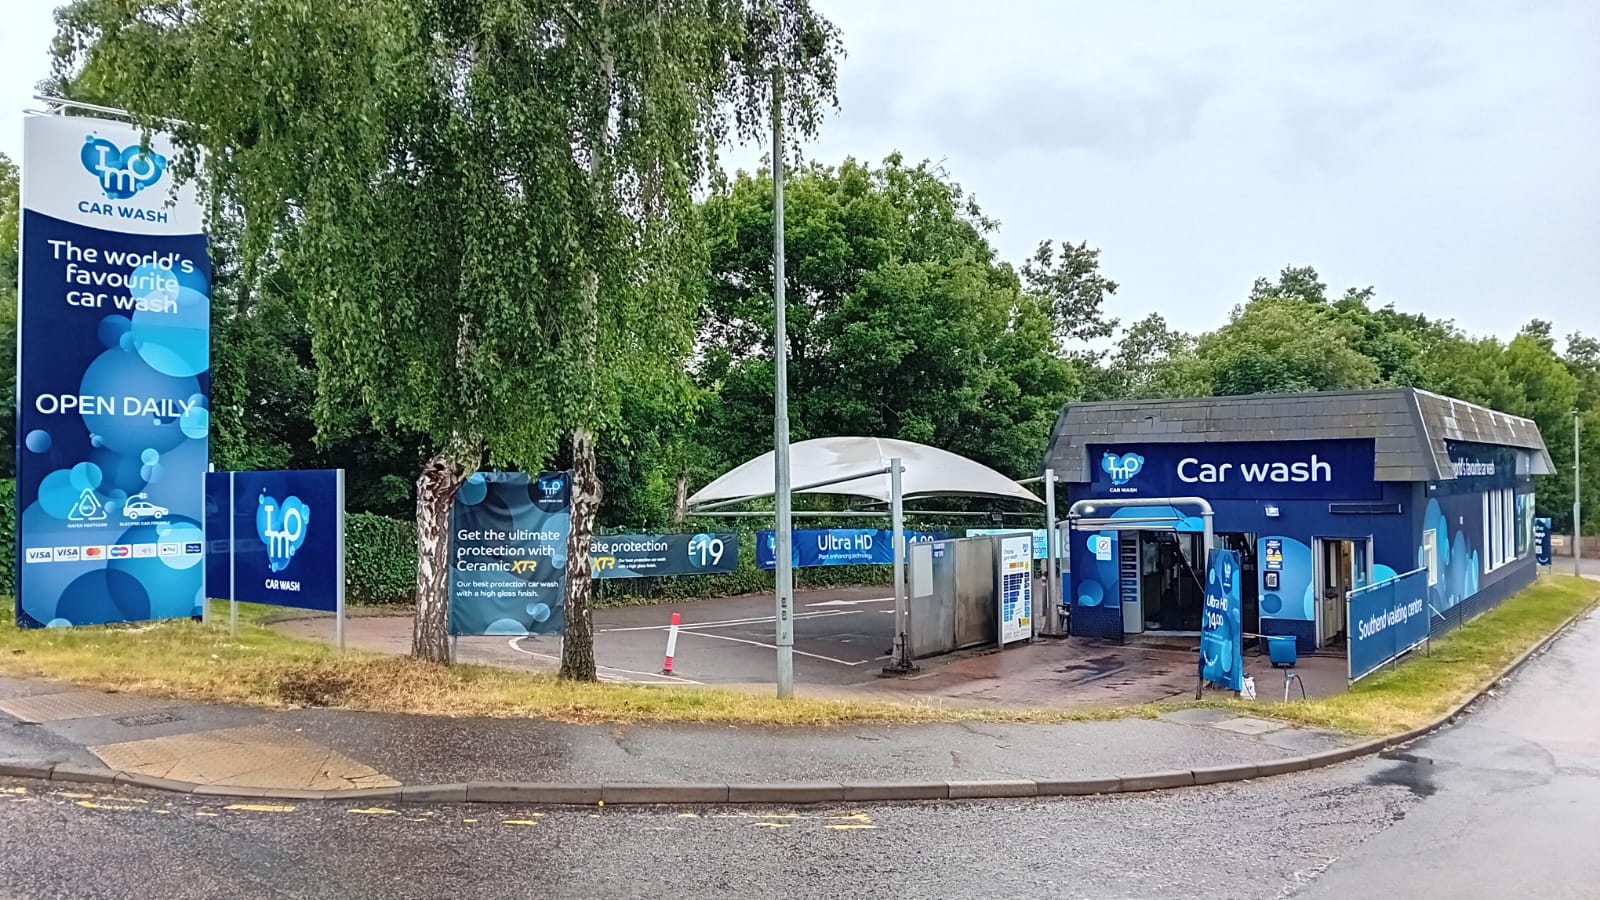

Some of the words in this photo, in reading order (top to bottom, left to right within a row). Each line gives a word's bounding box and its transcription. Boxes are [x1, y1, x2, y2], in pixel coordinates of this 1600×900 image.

[78, 200, 113, 216] CAR
[118, 205, 168, 223] WASH
[47, 239, 97, 263] The
[104, 250, 194, 274] world's
[66, 263, 179, 293] favourite
[66, 290, 107, 308] car
[113, 294, 178, 314] wash
[35, 393, 115, 416] OPEN
[123, 397, 195, 418] DAILY
[1177, 457, 1232, 483] Car
[1240, 454, 1331, 482] wash
[457, 530, 481, 541] Get
[484, 529, 505, 541] the
[508, 529, 560, 541] ultimate
[817, 534, 852, 551] Ultra
[855, 534, 873, 550] HD
[30, 551, 51, 559] VISA
[457, 545, 525, 561] protection
[528, 545, 555, 556] with
[611, 540, 668, 555] protection
[687, 538, 724, 566] £19
[457, 560, 511, 572] Ceramic
[511, 560, 537, 574] XTR
[593, 557, 616, 573] XTR
[265, 579, 279, 590] CAR
[280, 580, 301, 591] WASH
[490, 581, 527, 589] protection
[480, 590, 496, 599] high
[497, 590, 516, 598] gloss
[1206, 594, 1219, 609] Ultra
[1219, 597, 1229, 611] HD
[1358, 608, 1387, 641] Southend
[1387, 603, 1407, 624] valeting
[1407, 598, 1423, 617] centre
